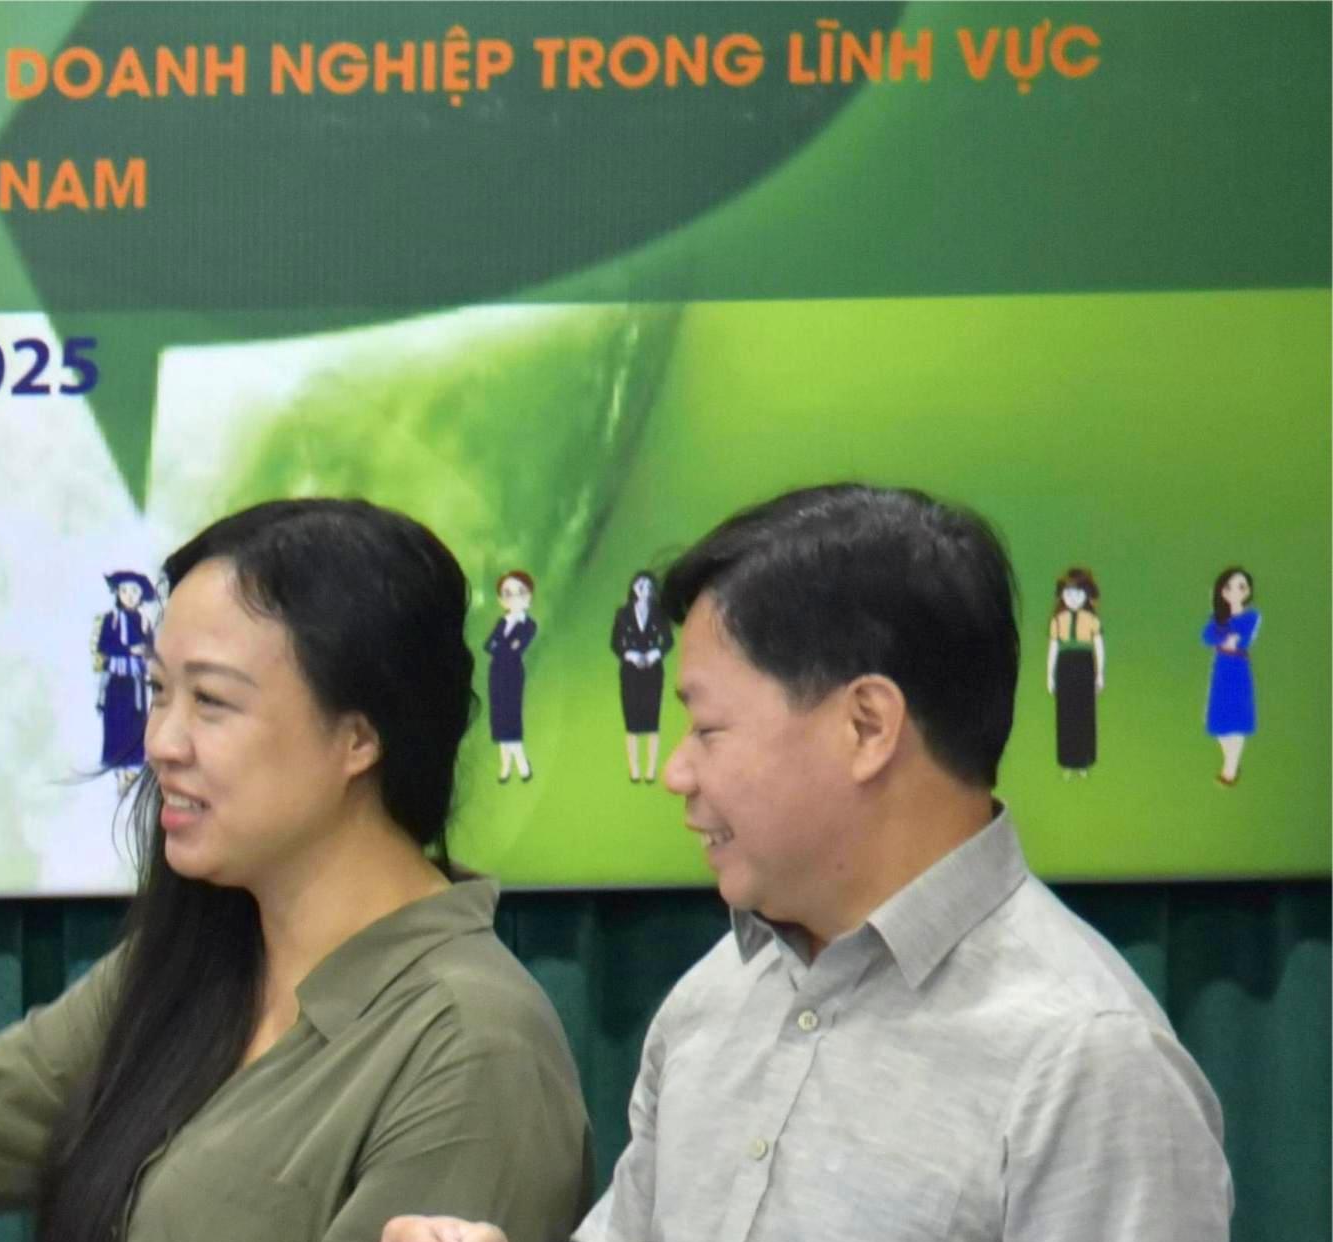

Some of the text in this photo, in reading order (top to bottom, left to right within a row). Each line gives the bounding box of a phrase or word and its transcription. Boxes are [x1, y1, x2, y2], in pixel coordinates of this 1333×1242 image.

[5, 44, 247, 100] DOANH
[270, 25, 514, 107] NGHIỆP
[533, 33, 765, 90] TRONG
[787, 19, 934, 85] LĨNH
[958, 20, 1103, 94] VỰC
